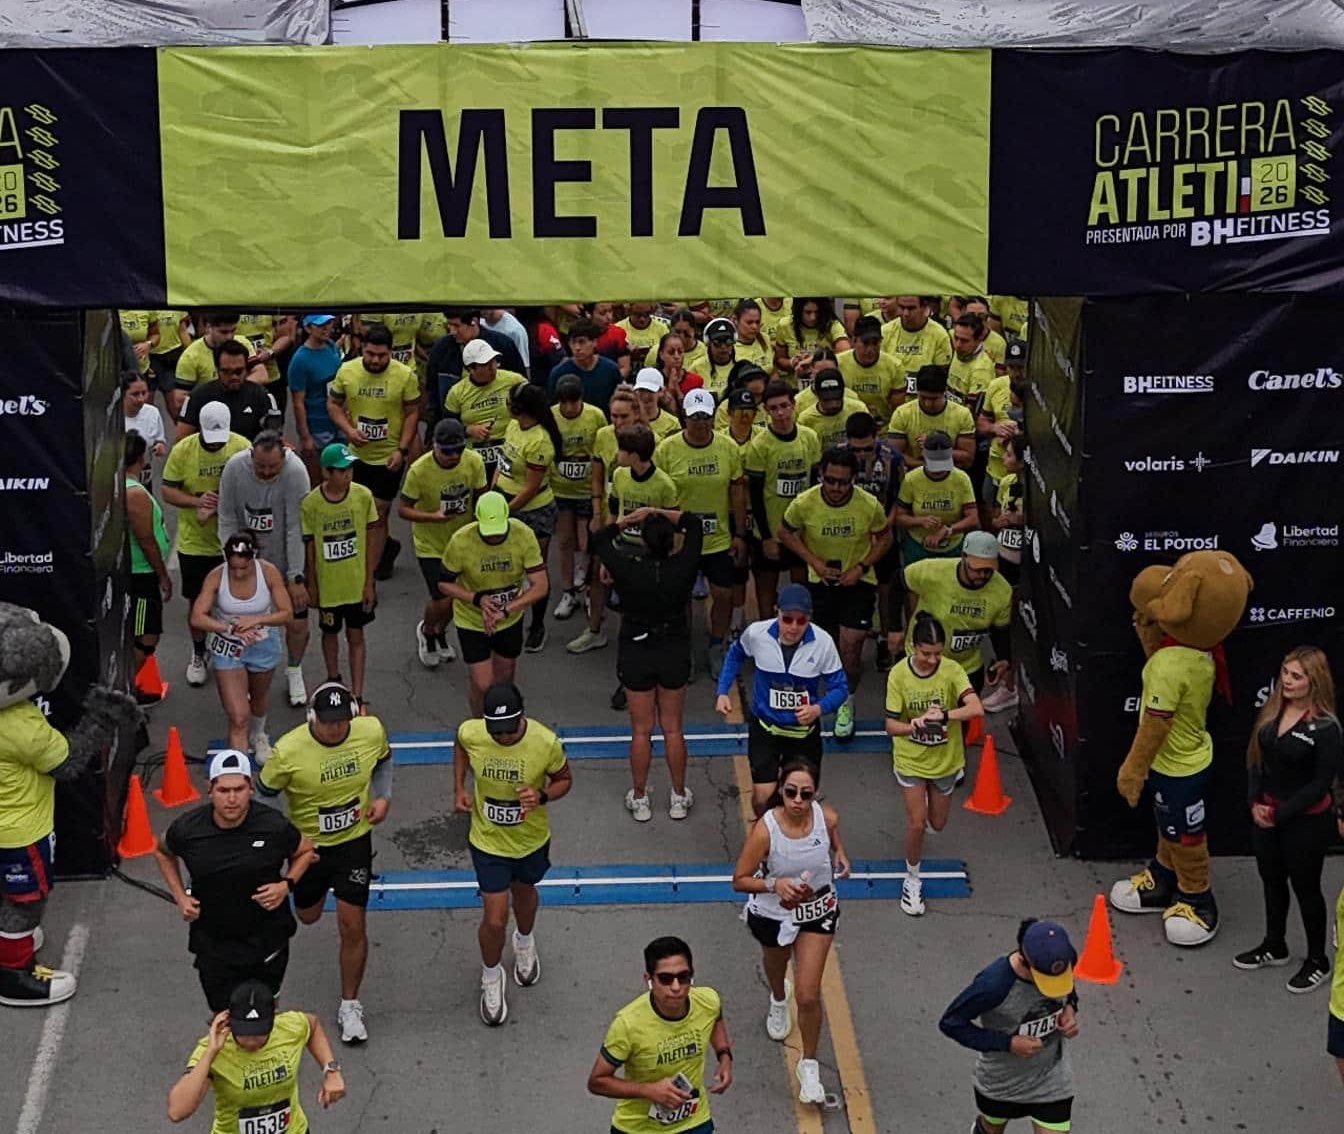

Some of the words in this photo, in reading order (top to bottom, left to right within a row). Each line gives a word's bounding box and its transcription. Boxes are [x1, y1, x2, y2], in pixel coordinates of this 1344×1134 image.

[1095, 99, 1297, 167] CARRERA
[397, 106, 767, 240] META
[1260, 162, 1289, 183] 20
[1087, 160, 1238, 226] ATLETI
[1260, 185, 1288, 205] 26
[1086, 225, 1159, 245] PRESENTADA
[1163, 223, 1186, 239] POR
[1190, 209, 1330, 247] BHFITNESS
[1123, 375, 1214, 393] BHFITNESS
[1248, 368, 1343, 390] Canel's
[1124, 456, 1185, 471] volaris
[1269, 450, 1340, 464] DAIKIN
[563, 464, 586, 477] 1037
[1283, 524, 1339, 537] Libertad
[1144, 538, 1161, 551] EL
[1164, 535, 1218, 550] POTOSÍ
[1267, 606, 1336, 620] CAFFENIO
[488, 806, 522, 822] 0557
